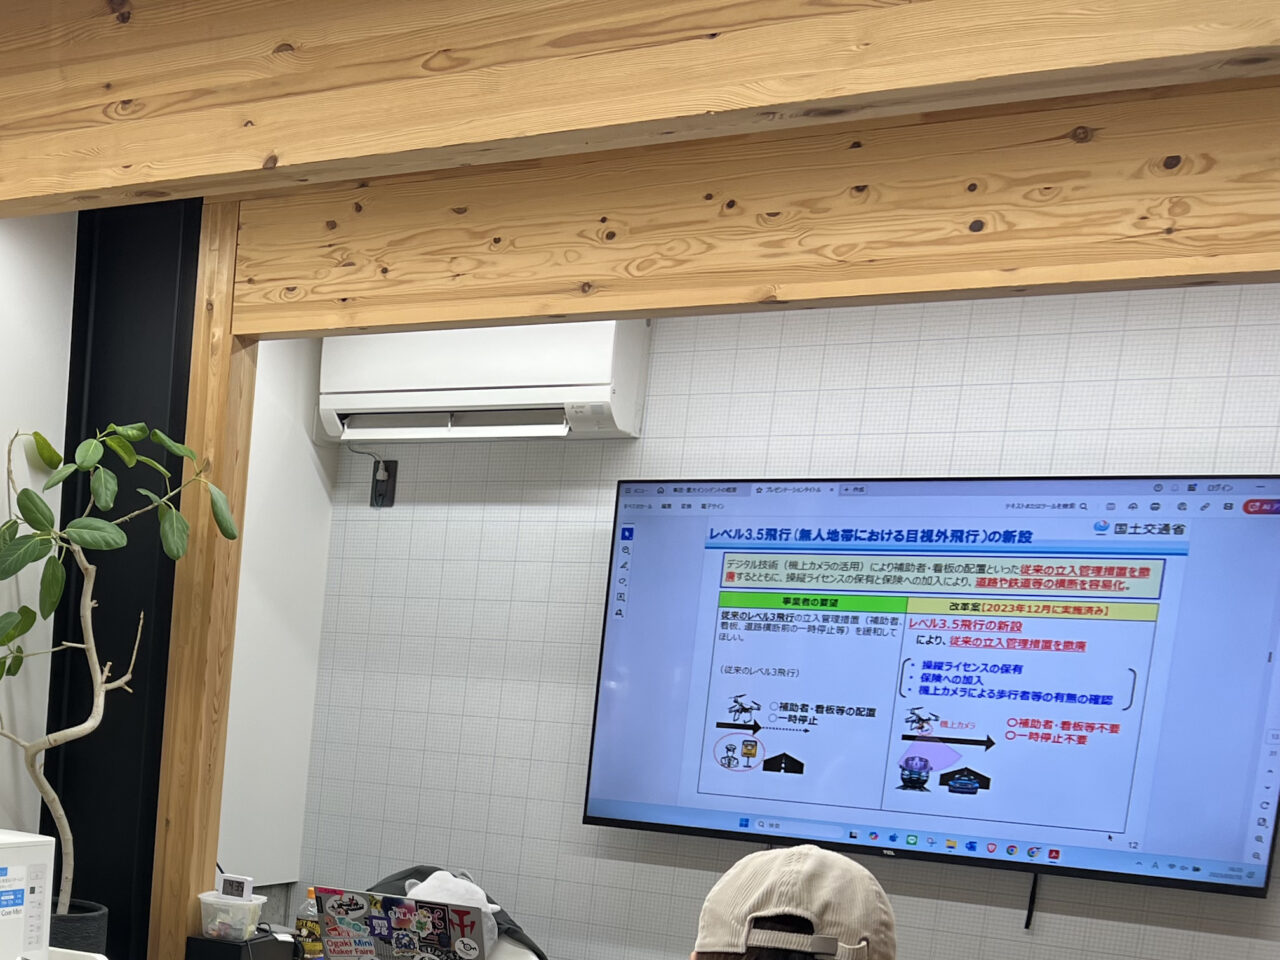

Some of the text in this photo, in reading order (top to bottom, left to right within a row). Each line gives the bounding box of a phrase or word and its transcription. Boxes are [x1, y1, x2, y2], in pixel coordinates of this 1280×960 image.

[1114, 522, 1187, 536] 国土交通省
[782, 596, 839, 608] 事業者の要望
[908, 618, 1023, 633] レベル3.5飛行の新設
[719, 633, 745, 642] ほしい。
[940, 720, 976, 730] 機上カメラ
[1128, 841, 1139, 850] 12
[326, 939, 373, 949] Ogaki Mini
[329, 947, 375, 956] Maker Faire
